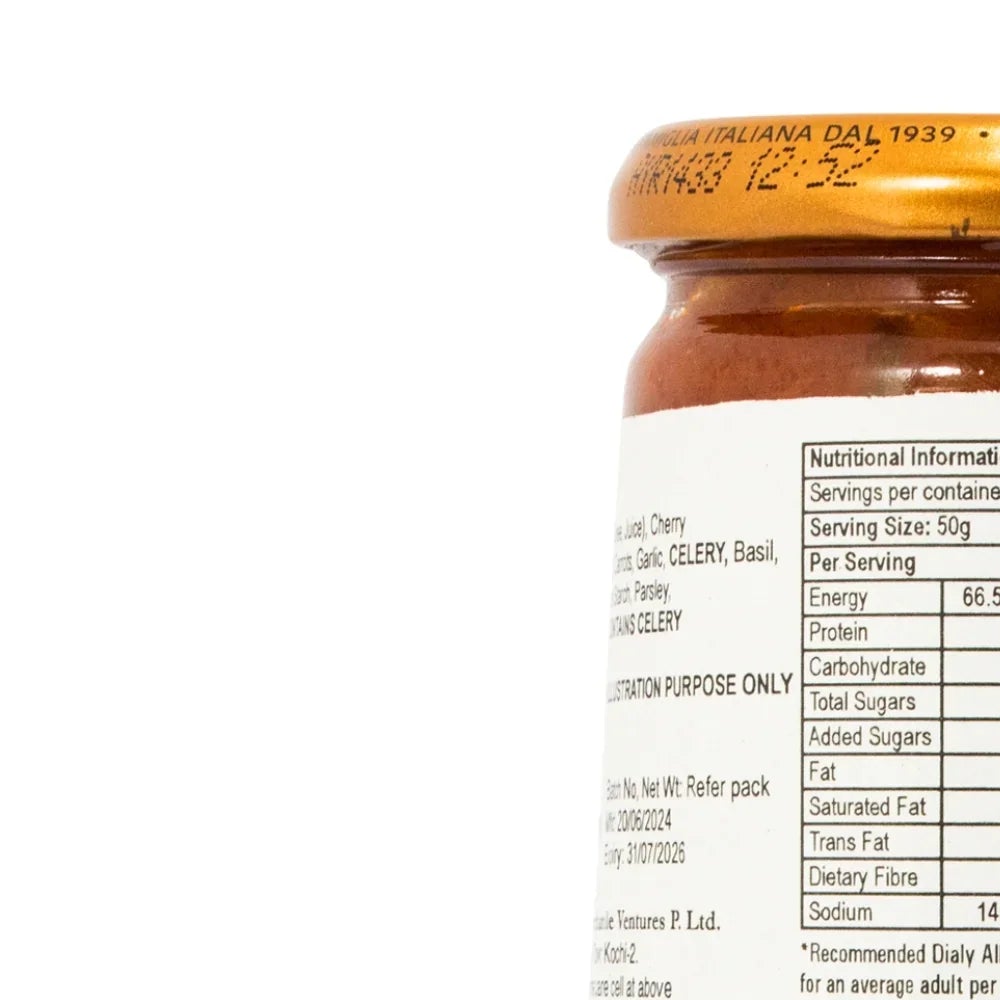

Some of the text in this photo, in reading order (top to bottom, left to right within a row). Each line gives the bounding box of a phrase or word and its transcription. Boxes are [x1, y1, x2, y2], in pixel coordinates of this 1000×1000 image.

[704, 125, 811, 143] ITALIANA
[823, 124, 878, 142] DAL
[889, 126, 956, 142] 1939
[810, 446, 904, 468] Nutritional
[810, 482, 882, 507] Servings
[889, 486, 918, 506] per
[650, 513, 686, 538] Cherry
[810, 515, 970, 541] Serving Size: 50g
[669, 541, 729, 567] CELERY,
[734, 539, 779, 565] Basil,
[810, 551, 915, 577] Per Serving
[810, 587, 868, 612] Energy
[638, 609, 682, 634] CELERY
[810, 621, 867, 642] Protein
[810, 656, 926, 681] Carbohydrate
[665, 673, 736, 697] PURPOSE
[742, 673, 793, 695] ONLY
[810, 691, 848, 711] Total
[854, 691, 916, 717] Sugars
[809, 726, 862, 746] Added
[869, 726, 932, 752] Sugars
[810, 761, 836, 781] Fat
[642, 777, 660, 798] Net
[687, 775, 726, 797] Refer
[731, 774, 770, 802] pack
[809, 796, 890, 816] Saturated
[897, 796, 926, 816] Fat
[618, 808, 671, 832] 20/06/2024
[627, 841, 685, 864] 31/07/2026
[810, 830, 856, 851] Trans
[862, 831, 889, 851] Fat
[809, 866, 868, 892] Dietary
[875, 866, 918, 886] Fibre
[617, 909, 665, 930] Ventures
[671, 910, 681, 930] P.
[686, 910, 720, 930] Ltd.
[809, 901, 872, 921] Sodium
[932, 943, 975, 968] Dialy
[638, 976, 672, 998] above
[800, 973, 821, 993] for
[826, 978, 844, 993] an
[851, 979, 913, 999] average
[920, 974, 963, 995] adult
[970, 980, 997, 1000] per
